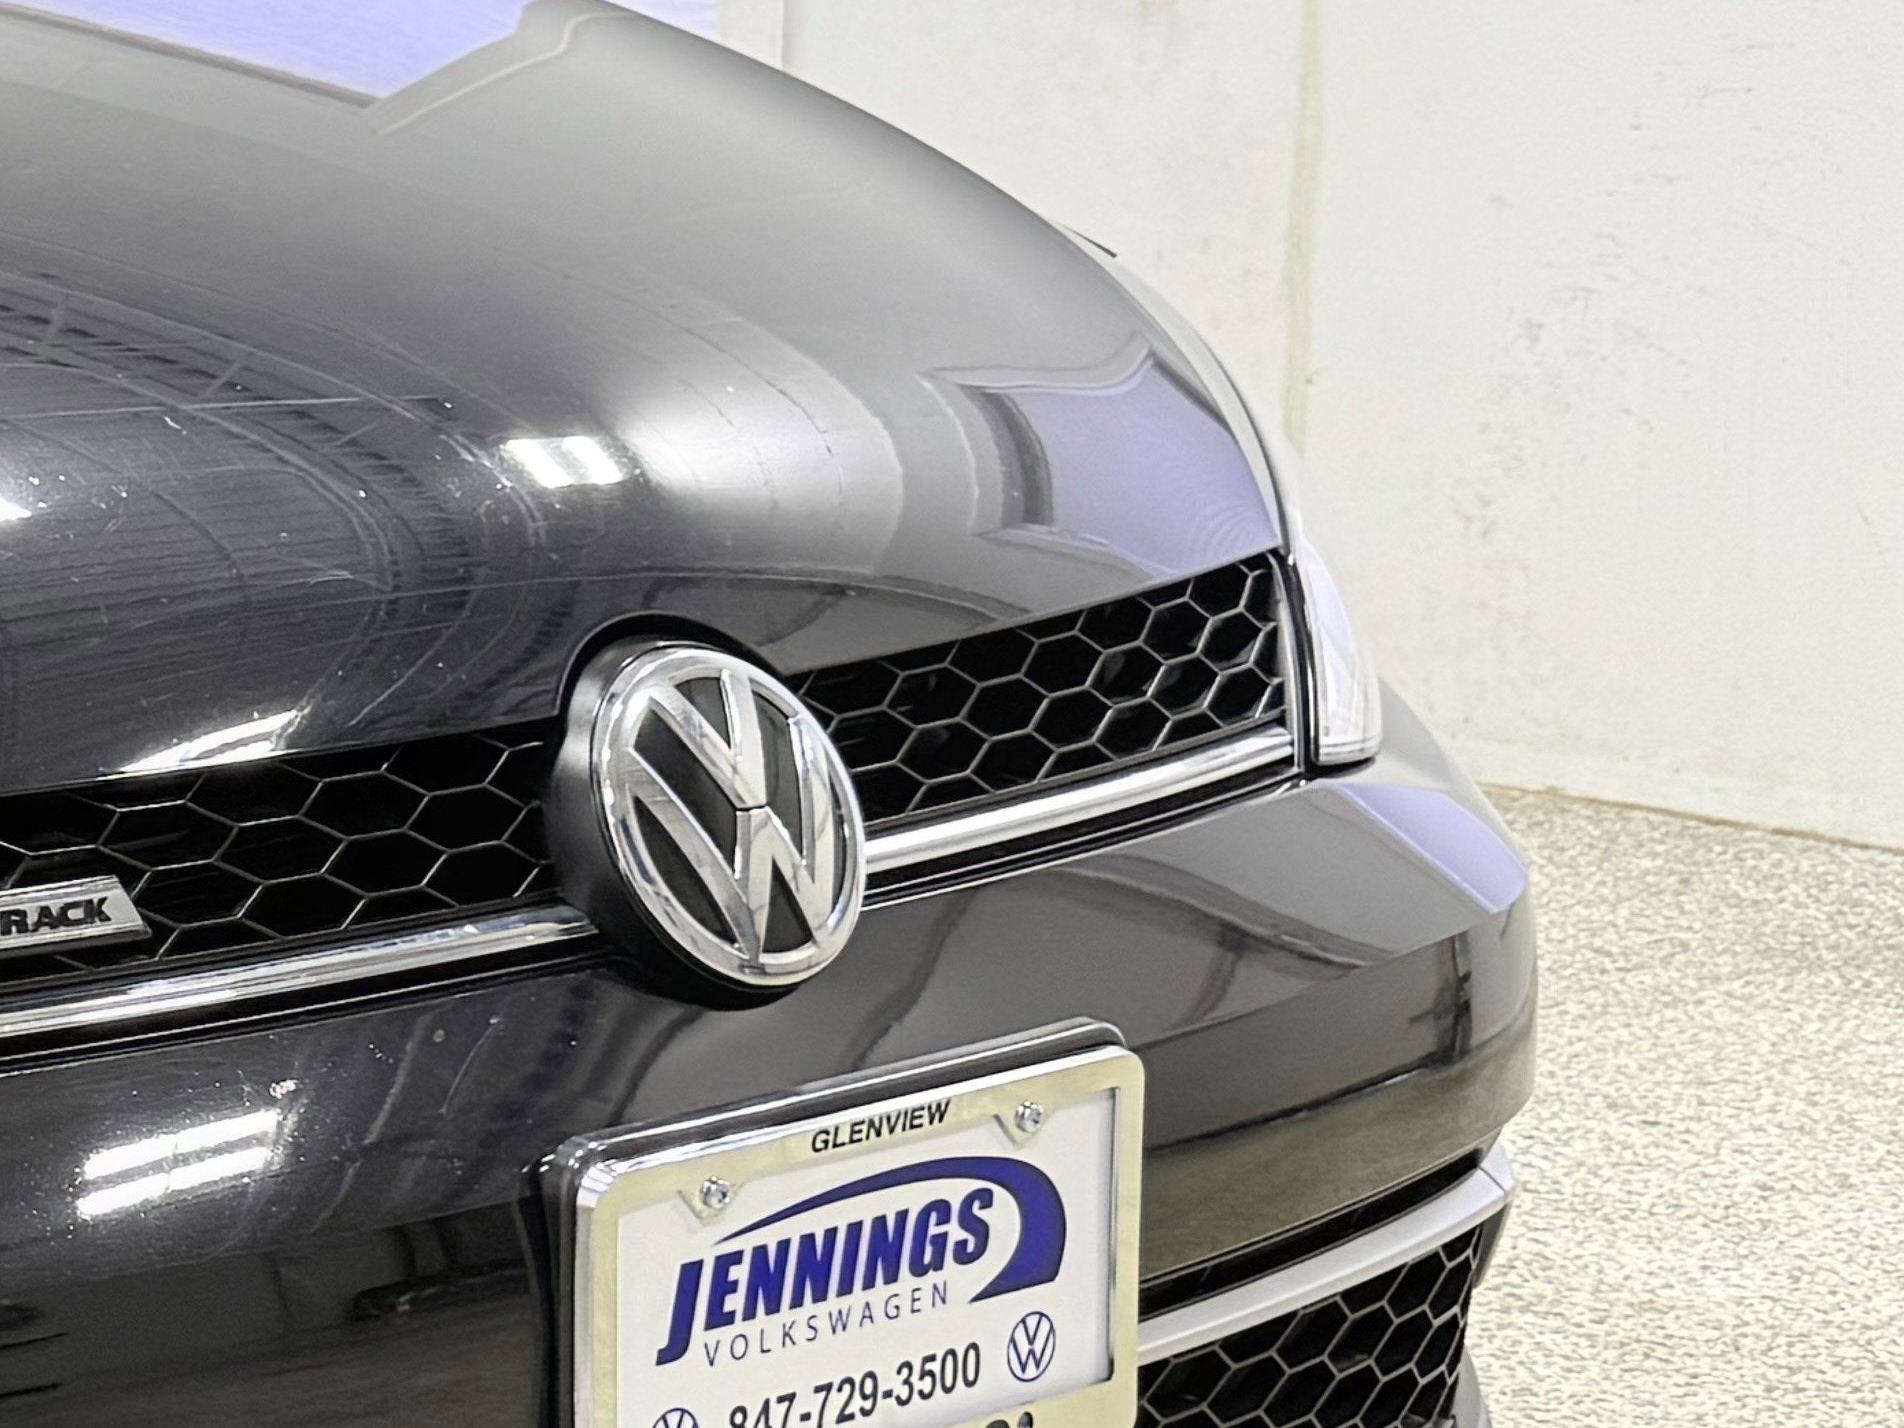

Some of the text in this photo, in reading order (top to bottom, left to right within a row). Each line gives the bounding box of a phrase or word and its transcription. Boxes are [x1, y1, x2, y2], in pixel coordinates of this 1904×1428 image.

[810, 1097, 951, 1154] GLENVIEW
[655, 1186, 995, 1367] JENNINGS
[703, 1278, 948, 1368] VOLKSWAGEN
